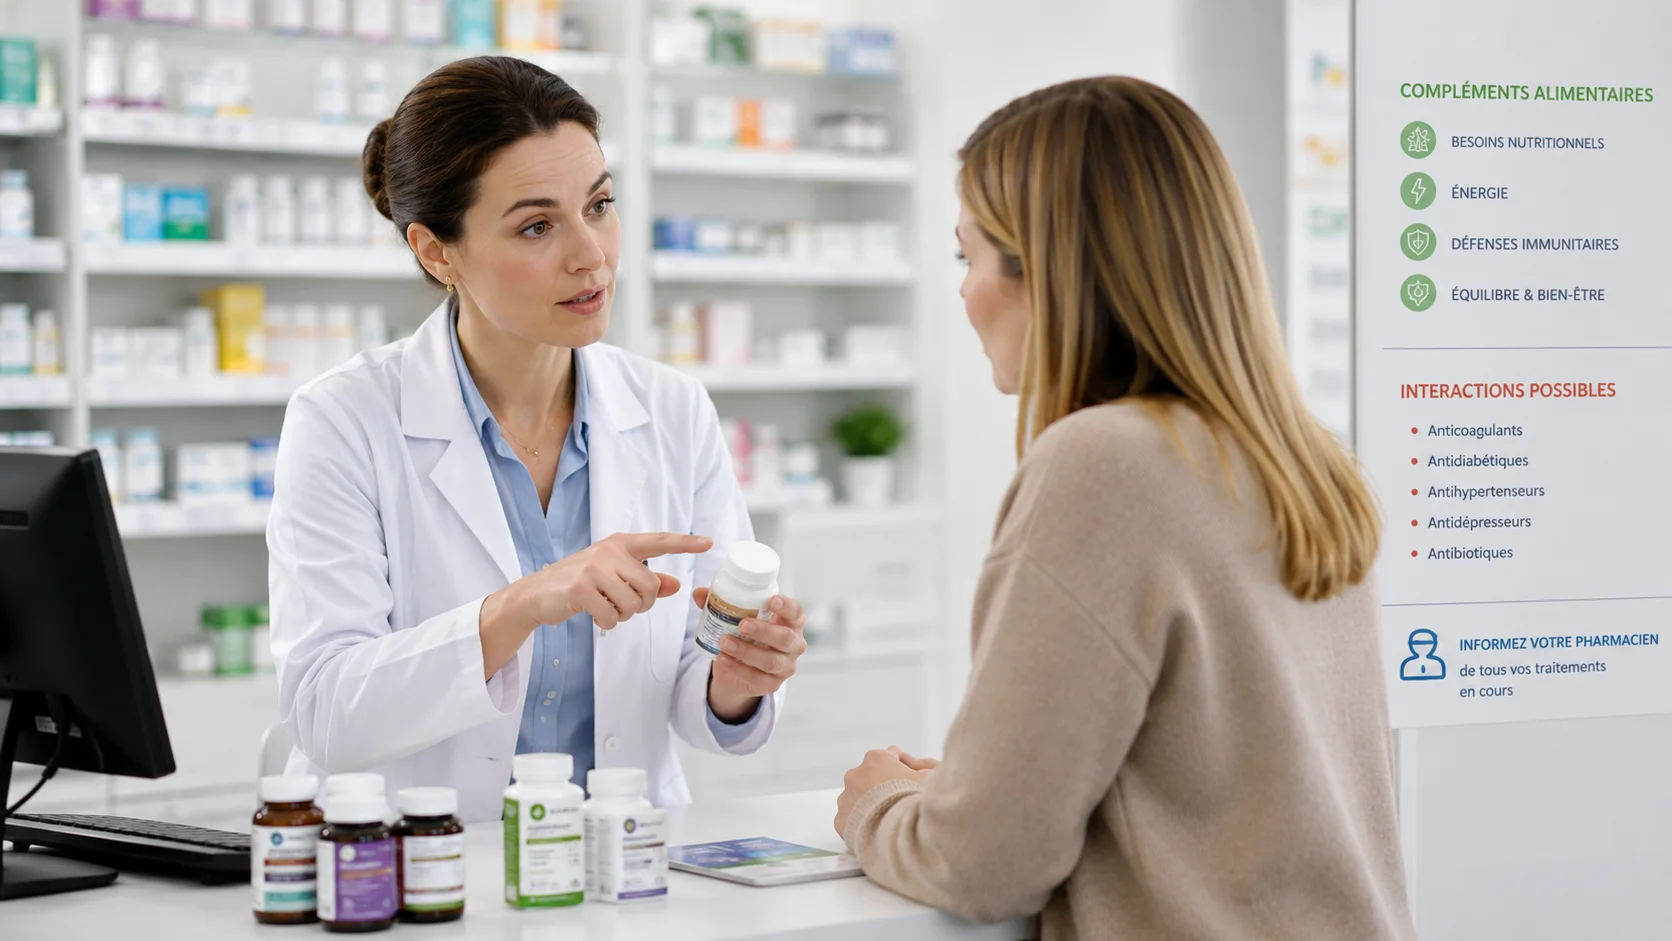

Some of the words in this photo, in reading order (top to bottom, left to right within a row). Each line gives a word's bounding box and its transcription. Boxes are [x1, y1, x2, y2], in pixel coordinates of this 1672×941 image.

[1400, 80, 1529, 100] COMPLÉMENTS
[1534, 86, 1653, 102] ALIMENTAIRES
[1452, 136, 1504, 148] BESOINS
[1508, 137, 1604, 149] NUTRITIONNELS
[1452, 184, 1508, 199] ÉNERGIE
[1452, 235, 1518, 250] DÉFENSES
[1523, 238, 1619, 250] IMMUNITAIRES
[1452, 286, 1520, 302] ÉQUILIBRE
[1524, 289, 1533, 301] &
[1538, 286, 1605, 301] BIEN-ÊTRE
[1401, 383, 1524, 399] INTERACTIONS
[1530, 382, 1616, 398] POSSIBLES
[1428, 424, 1523, 439] Anticoagulants
[1428, 454, 1528, 469] Antidiabétiques
[1428, 485, 1545, 501] Antihypertenseurs
[1428, 516, 1531, 531] Antidépresseurs
[1428, 546, 1513, 561] Antibiotiques
[1460, 637, 1527, 651] INFORMEZ
[1530, 636, 1572, 648] VOTRE
[1576, 634, 1658, 647] PHARMACIEN
[1460, 664, 1475, 677] de
[1479, 665, 1506, 676] tous
[1510, 666, 1531, 675] vos
[1535, 661, 1606, 674] traitements
[1460, 688, 1475, 698] en
[1479, 687, 1513, 697] cours
